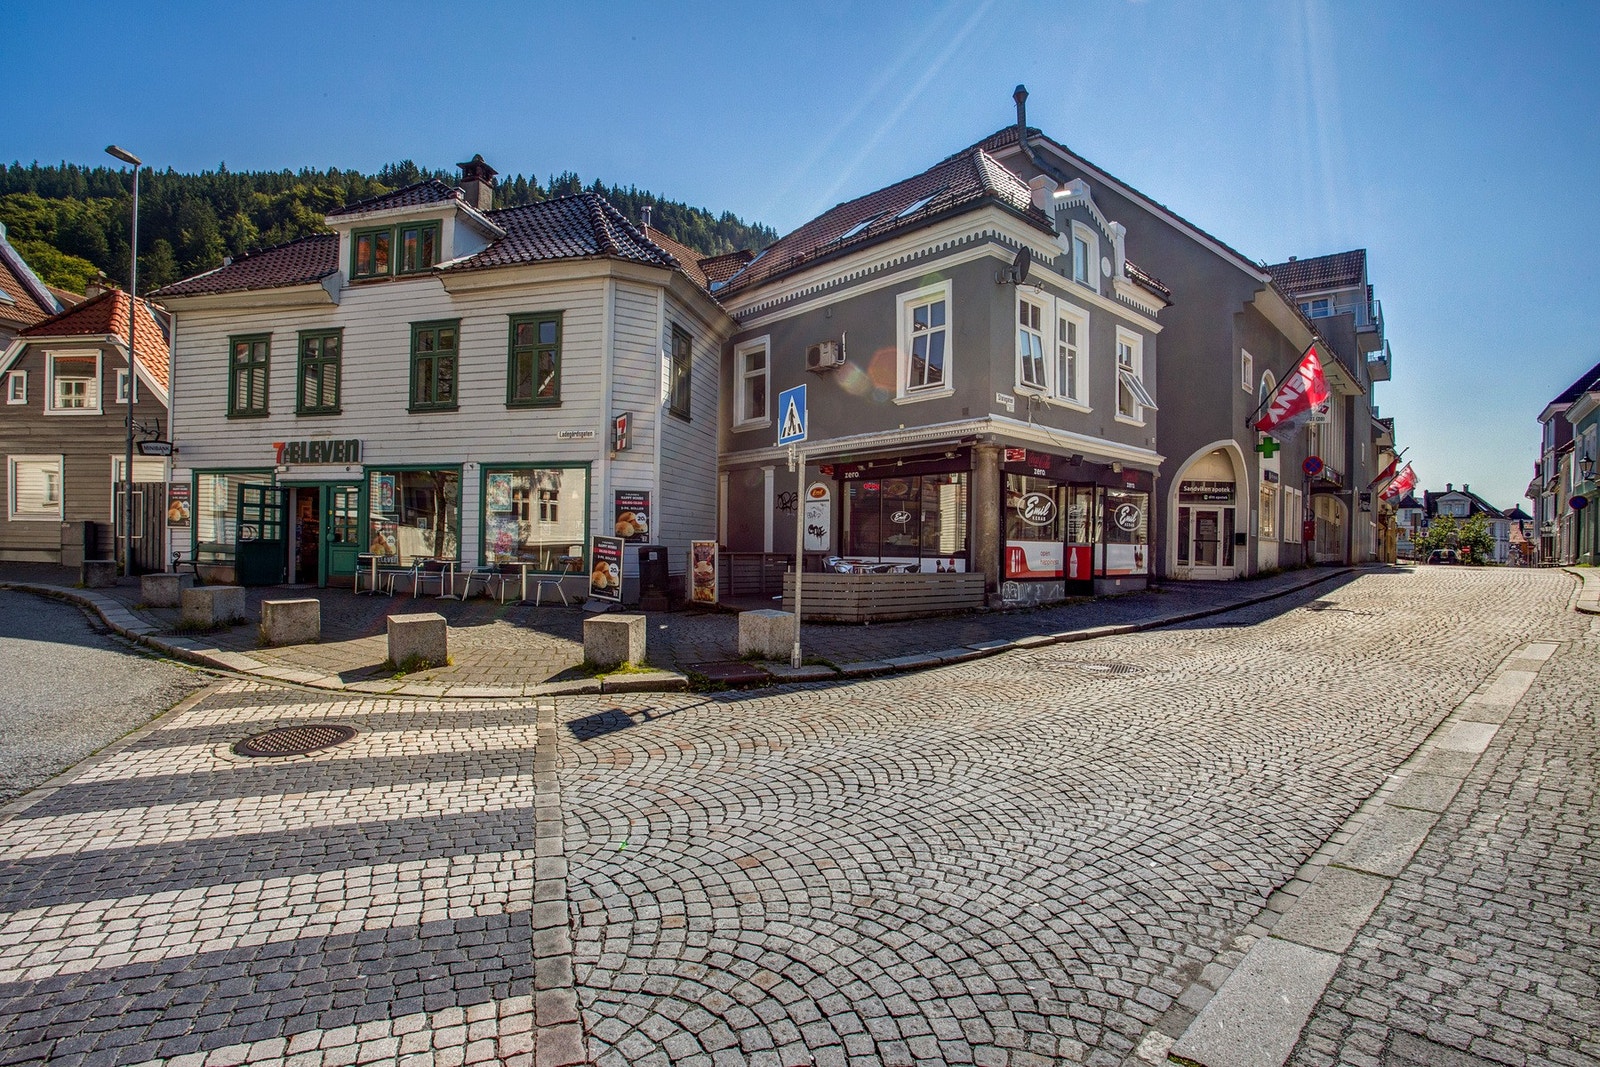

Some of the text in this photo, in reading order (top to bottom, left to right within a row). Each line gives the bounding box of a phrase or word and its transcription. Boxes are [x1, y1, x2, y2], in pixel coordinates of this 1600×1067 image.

[1268, 354, 1321, 424] MENY
[559, 430, 593, 439] Ladegårdsgaten
[863, 482, 880, 491] OPEN
[1025, 496, 1051, 519] Emil
[1119, 505, 1138, 525] Emil
